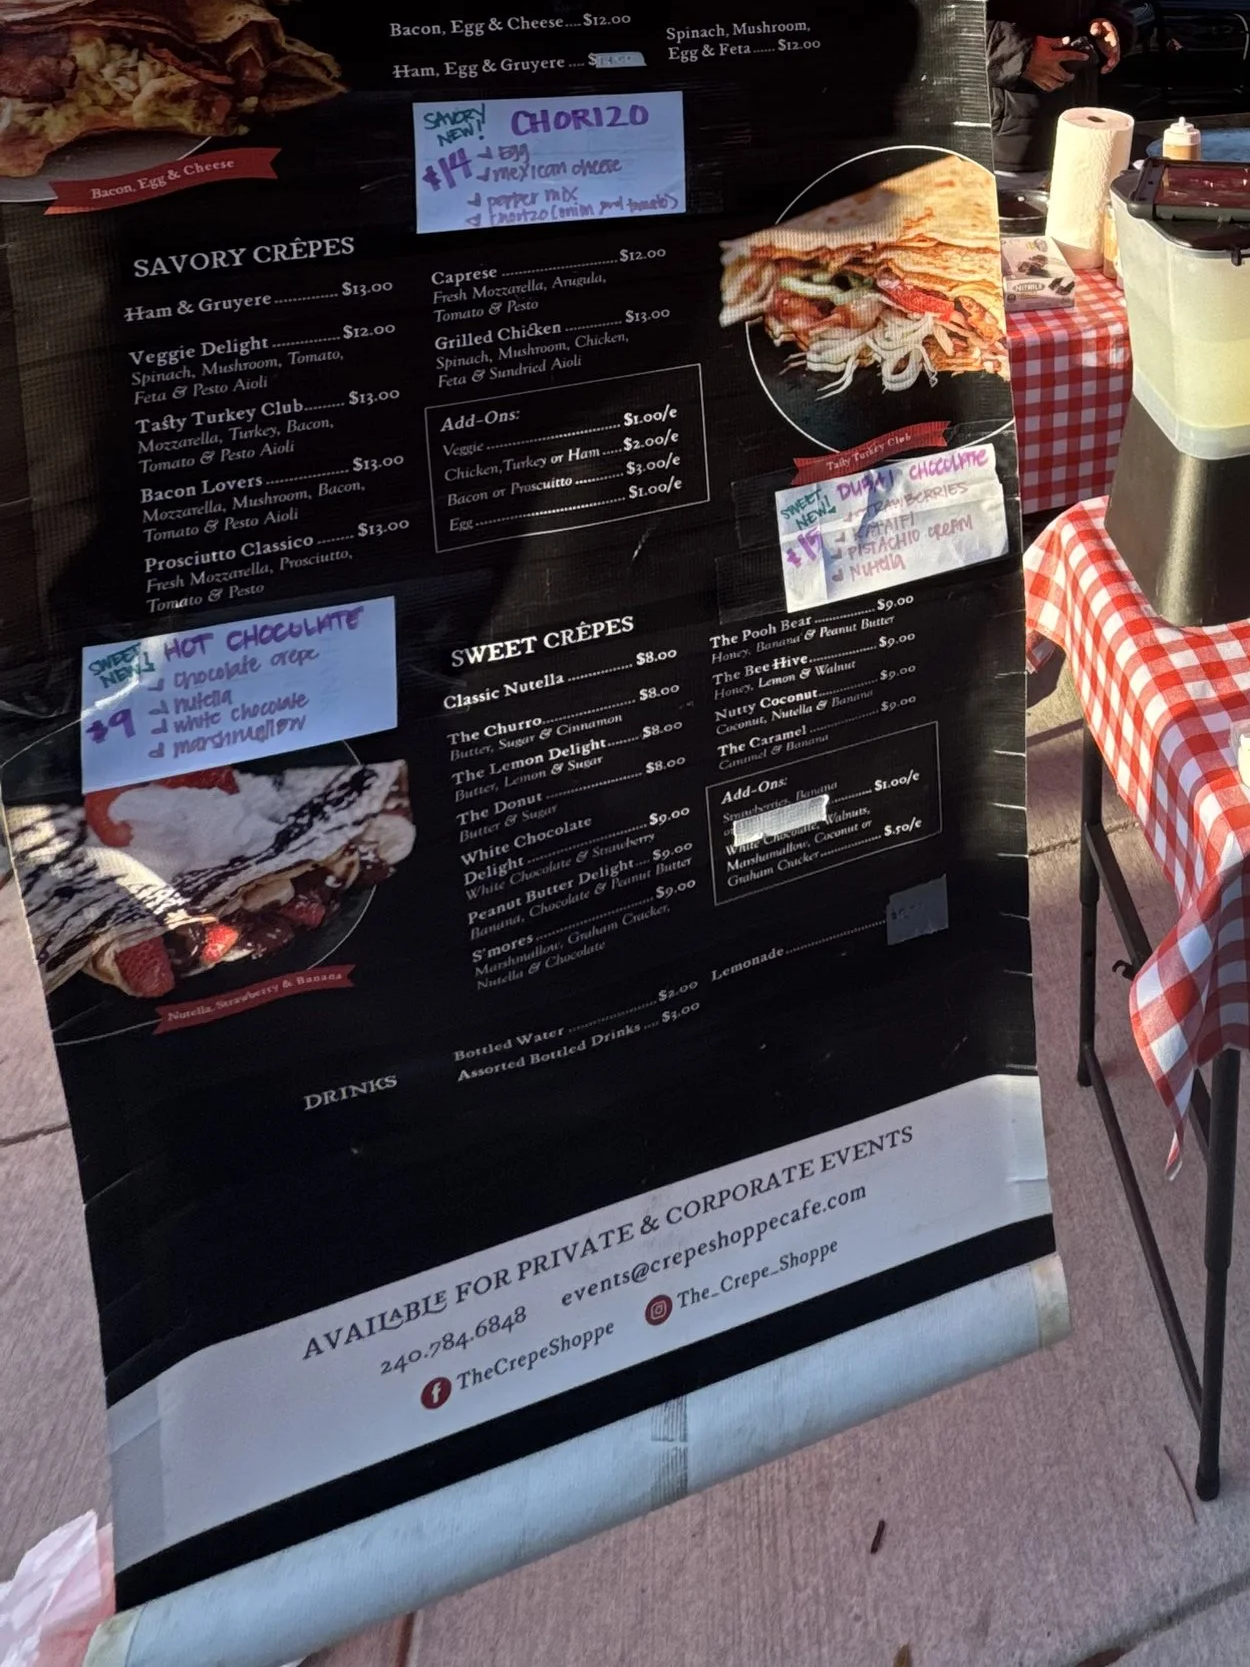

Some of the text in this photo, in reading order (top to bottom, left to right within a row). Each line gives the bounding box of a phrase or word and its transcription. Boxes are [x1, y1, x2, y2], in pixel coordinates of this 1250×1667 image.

[389, 13, 631, 38] Bacon, Egg & Cheese $12.00
[666, 18, 811, 43] Spinach, Mushroom,
[667, 38, 821, 63] Egg & Feta $12.00
[423, 103, 485, 130] SAVORY
[90, 159, 235, 200] Bacon, Egg & Cheese
[133, 237, 355, 278] SAVORY CRÊPES
[430, 248, 666, 287] Caprese $12.00
[124, 281, 393, 322] Ham & Gruyere $13.00
[433, 299, 539, 323] Tomato & Pesto
[128, 324, 396, 367] Veggie Delight $12.00
[434, 308, 671, 351] Grilled Chicken $13.00
[131, 349, 344, 387] Spinach, Mushroom, Tomato,
[435, 331, 629, 372] Spinach, Mushroom, Chicken,
[437, 354, 582, 389] Feta & Sundried Aioli
[133, 375, 268, 405] Feta & Pesto Aioli
[440, 409, 521, 432] Add-Ons:
[138, 440, 295, 474] Tomato & Pesto Aioli
[140, 455, 404, 504] Bacon Lovers $13.00
[143, 508, 299, 543] Tomato & Pesto Aioli
[144, 519, 410, 573] Prosciutto Classico $13.00
[146, 583, 264, 614] Tomato & Pesto
[164, 633, 214, 662] HOT
[226, 606, 365, 653] CHOCOLATE
[451, 615, 635, 668] SWEET CRÊPES
[709, 595, 915, 650] The Pooh Bear $9.00
[443, 649, 678, 710] Classic Nutella $8.00
[446, 684, 680, 746] The Churro $8.00
[717, 695, 917, 758] The Caramel $9.00
[451, 720, 683, 786] The Lemon Delight $8.00
[455, 755, 686, 827] The Donut $8.00
[460, 816, 593, 866] White Chocolate
[463, 807, 690, 886] Delight $9.00
[467, 842, 693, 925] Peanut Butter Delight $9.00
[711, 947, 784, 982] Lemonade
[453, 980, 699, 1062] Bottled Water $2.00
[457, 1002, 701, 1083] Assorted Bottled Drinks $3.00
[303, 1074, 399, 1112] DRINKS
[302, 1125, 914, 1361] AVAILABLE FOR PRIVATE & CORPORATE EVENTS
[560, 1184, 867, 1307] events@crepeshoppecafe.com
[676, 1239, 839, 1309] The_Crepe_Shoppe
[379, 1305, 528, 1376] 240.784.6848
[456, 1321, 615, 1390] TheCrepeShoppe
